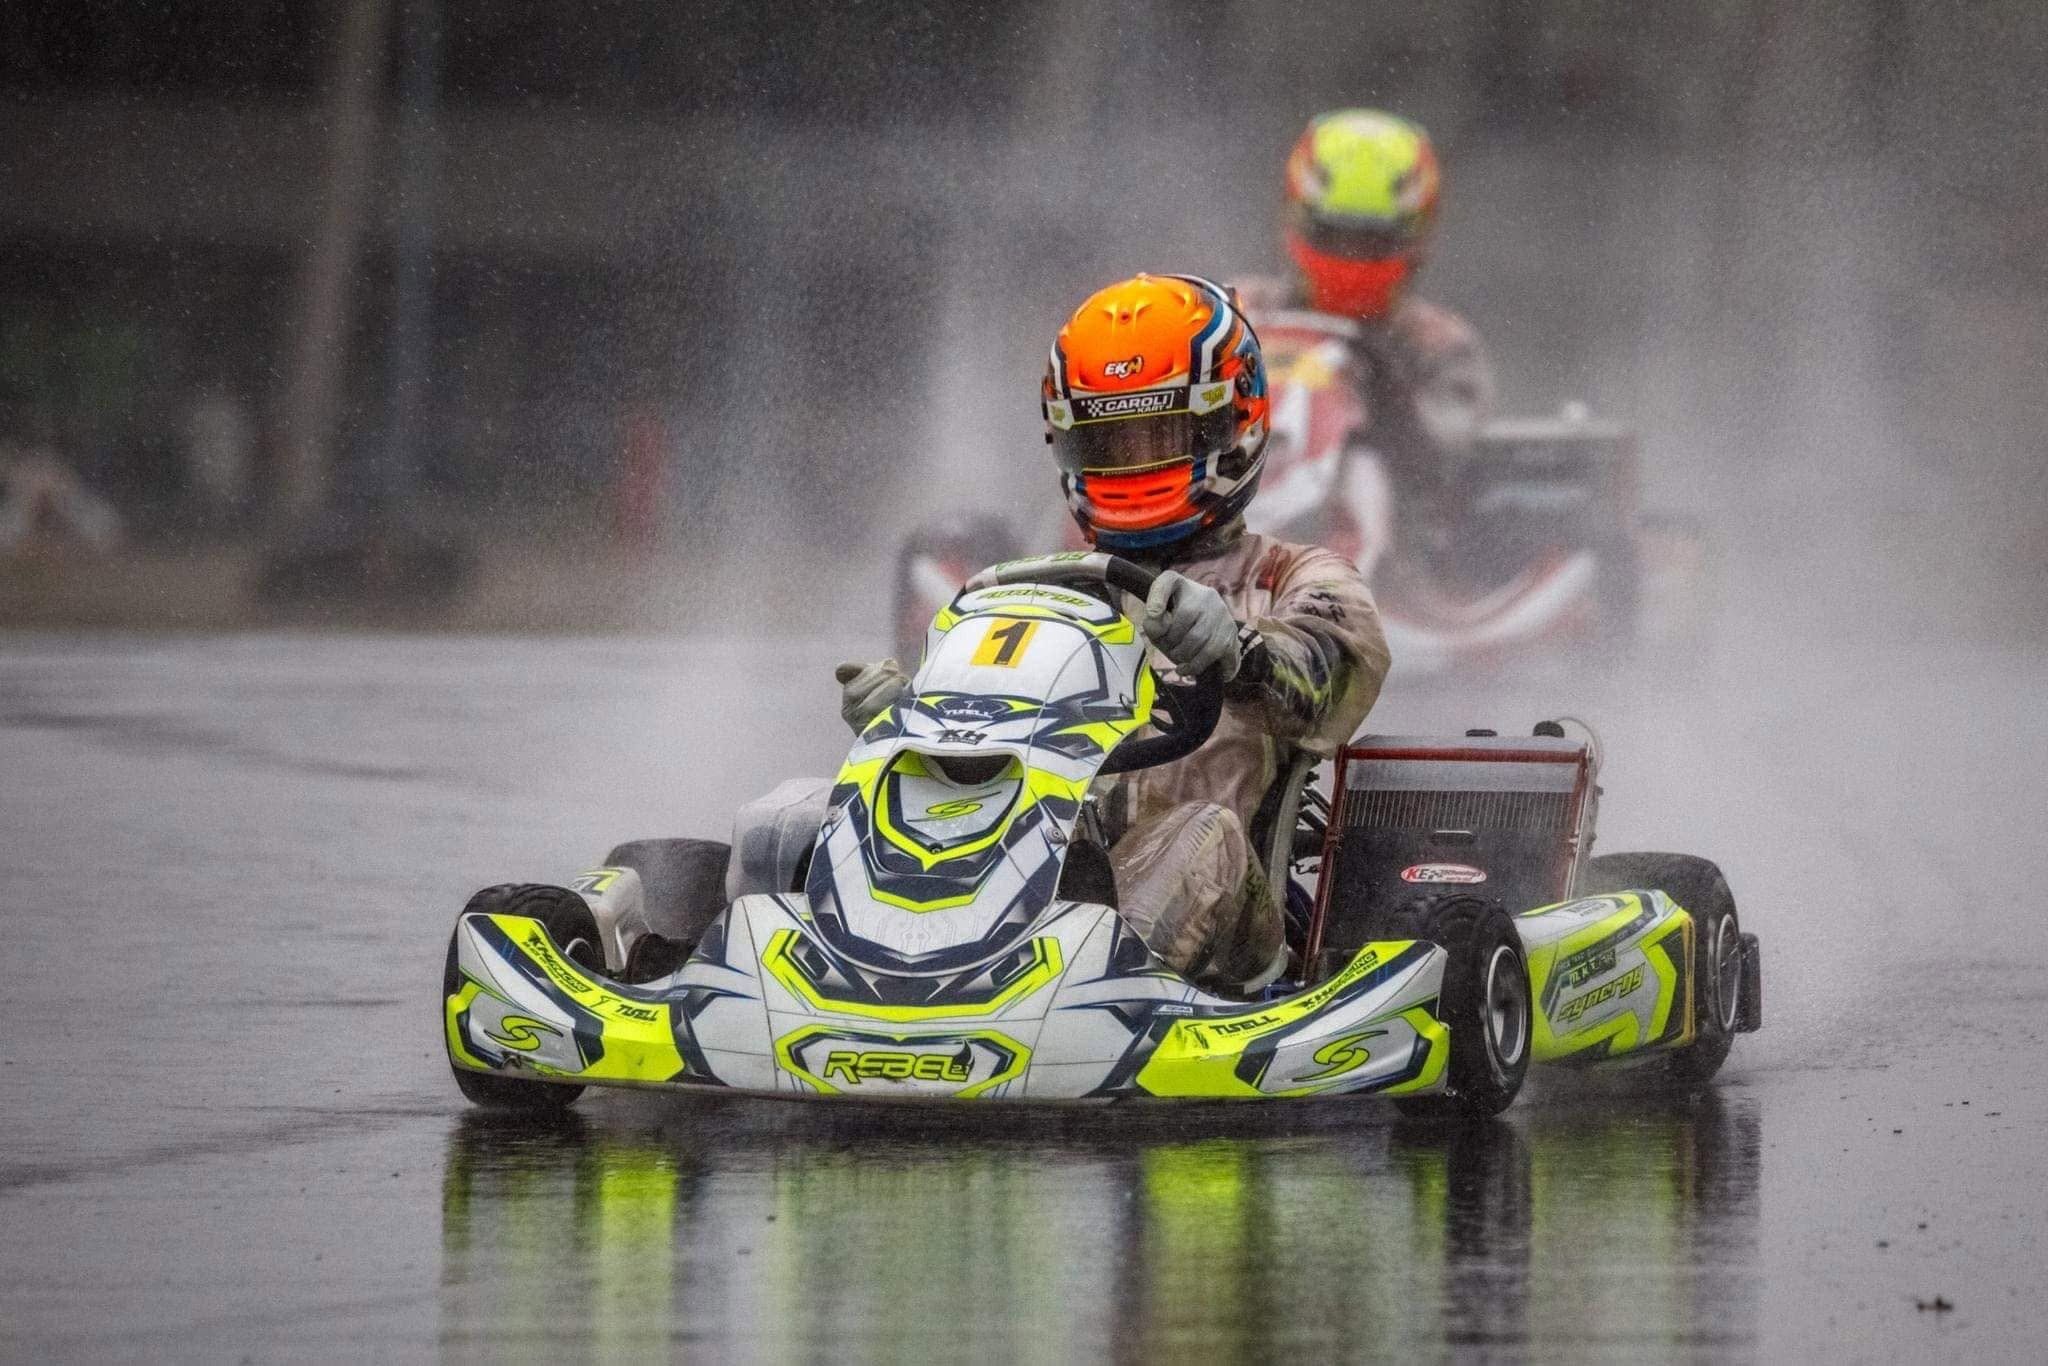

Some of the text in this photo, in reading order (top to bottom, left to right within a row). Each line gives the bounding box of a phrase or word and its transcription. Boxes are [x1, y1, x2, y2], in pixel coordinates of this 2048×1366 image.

[1105, 395, 1168, 411] CAROLI
[1137, 405, 1164, 414] KART
[992, 621, 1032, 666] 1
[824, 1051, 969, 1085] REBEL
